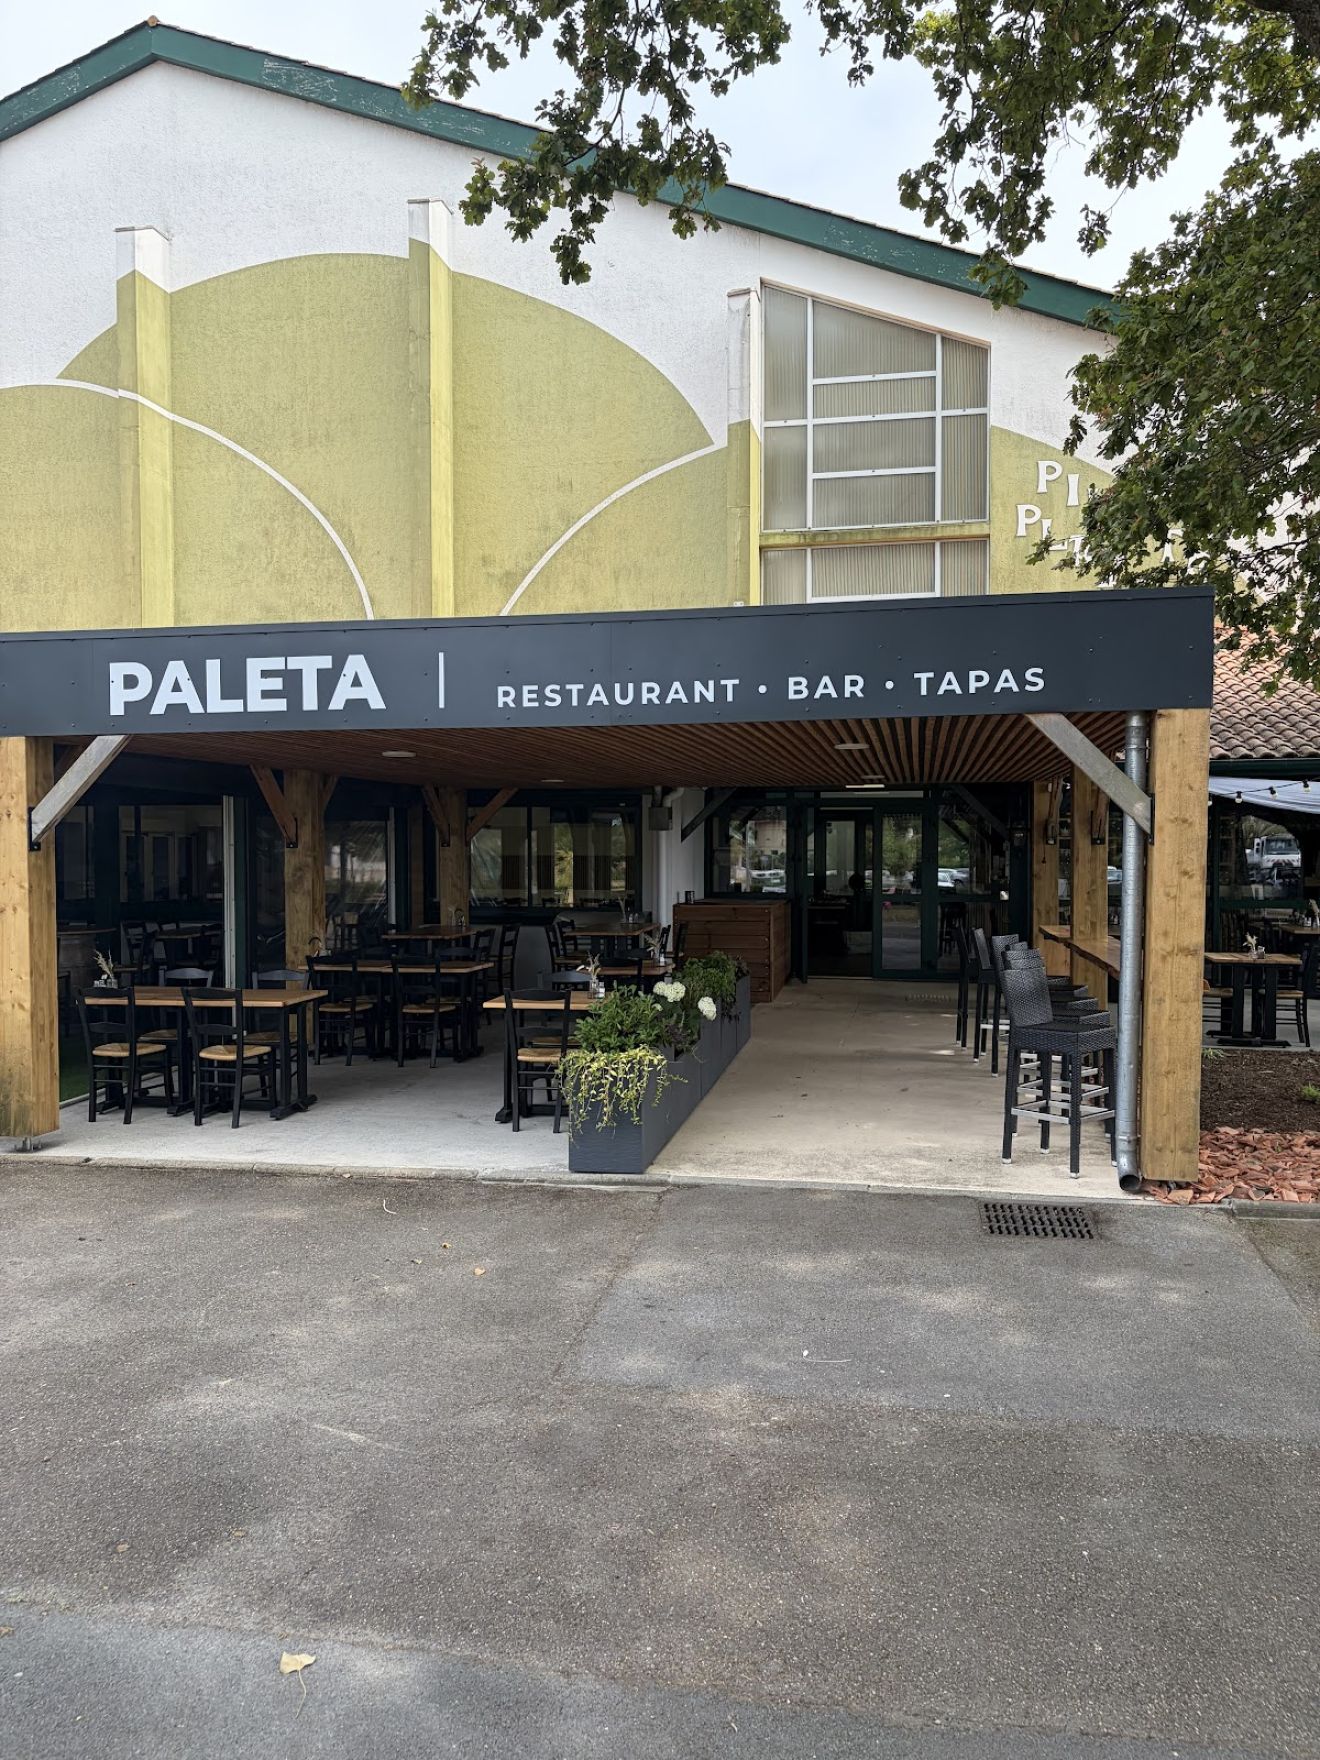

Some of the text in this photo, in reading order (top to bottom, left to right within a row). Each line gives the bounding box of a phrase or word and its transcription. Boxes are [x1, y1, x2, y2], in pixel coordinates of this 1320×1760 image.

[109, 653, 387, 716] PALETA
[497, 667, 1045, 710] RESTAURANT BAR TAPAS
